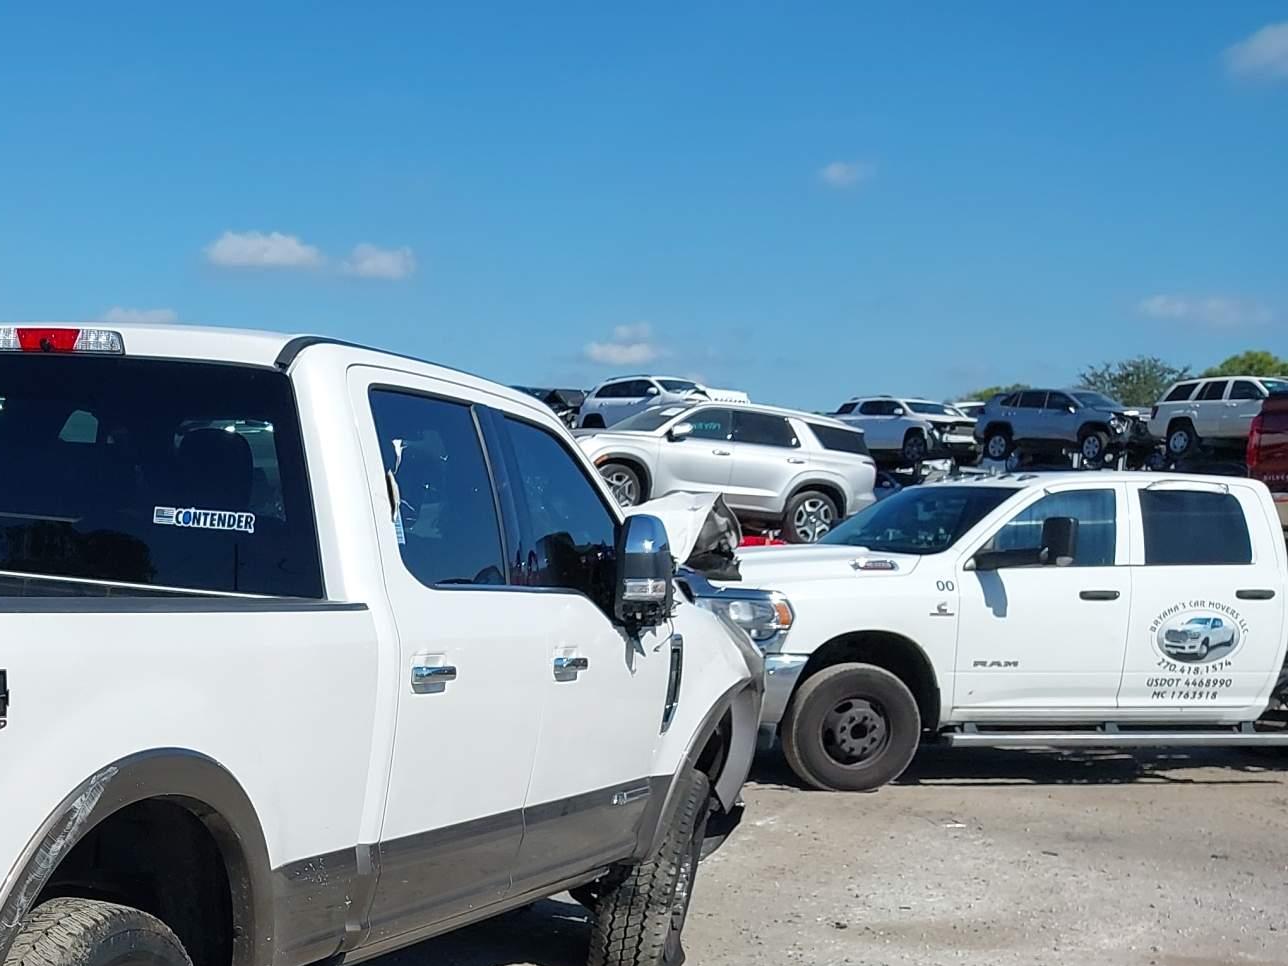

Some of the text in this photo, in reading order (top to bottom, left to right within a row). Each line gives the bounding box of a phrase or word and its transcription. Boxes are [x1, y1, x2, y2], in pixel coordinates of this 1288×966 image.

[174, 509, 253, 530] CONTENDER
[1189, 600, 1206, 608] CAR
[1208, 601, 1241, 620] MOVERS
[1239, 619, 1249, 633] LLC
[972, 660, 1019, 668] RAM
[1146, 678, 1233, 688] USDOT 4468990
[1152, 690, 1166, 699] MC
